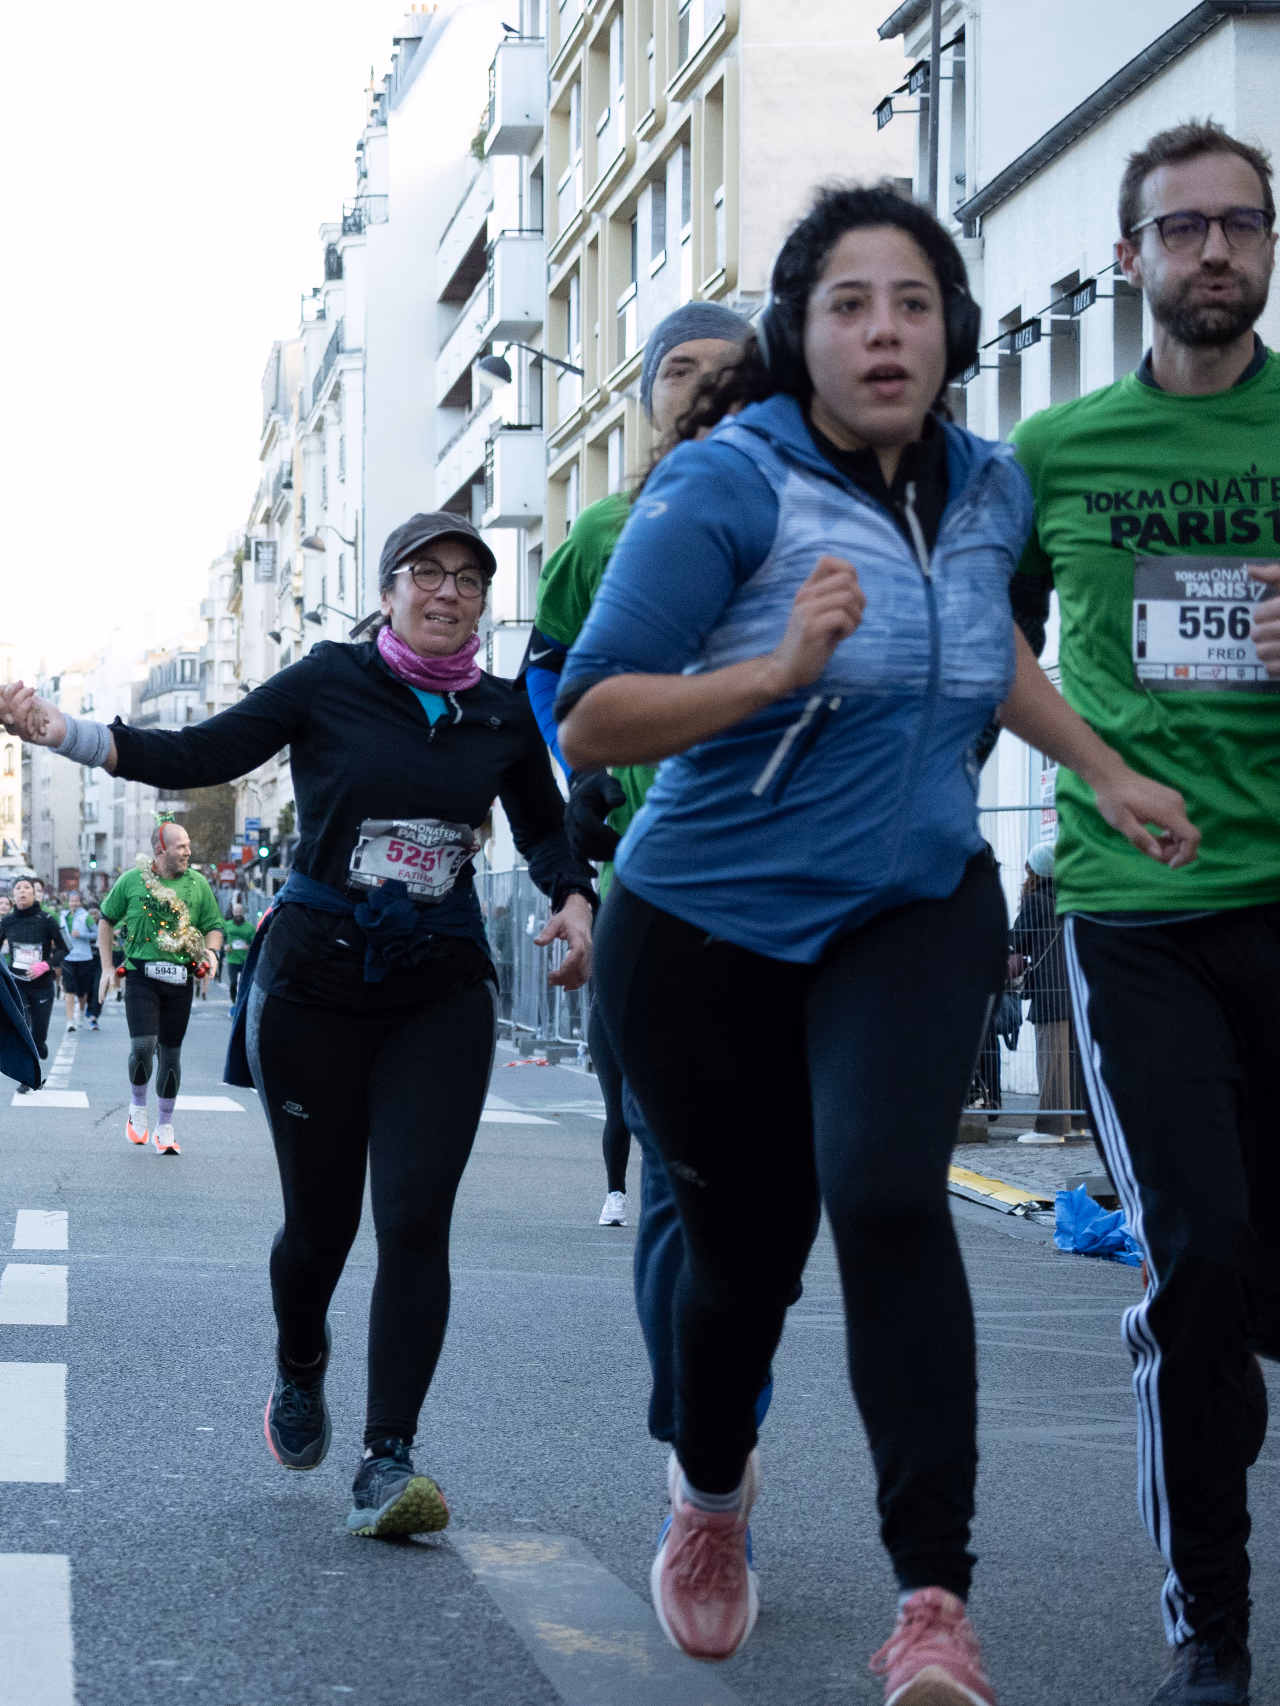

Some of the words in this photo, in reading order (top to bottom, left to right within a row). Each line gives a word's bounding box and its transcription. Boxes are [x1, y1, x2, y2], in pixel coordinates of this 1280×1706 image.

[1179, 605, 1251, 640] 556
[1207, 648, 1246, 660] FRED
[397, 869, 434, 884] FATIHA
[155, 967, 177, 975] 5943
